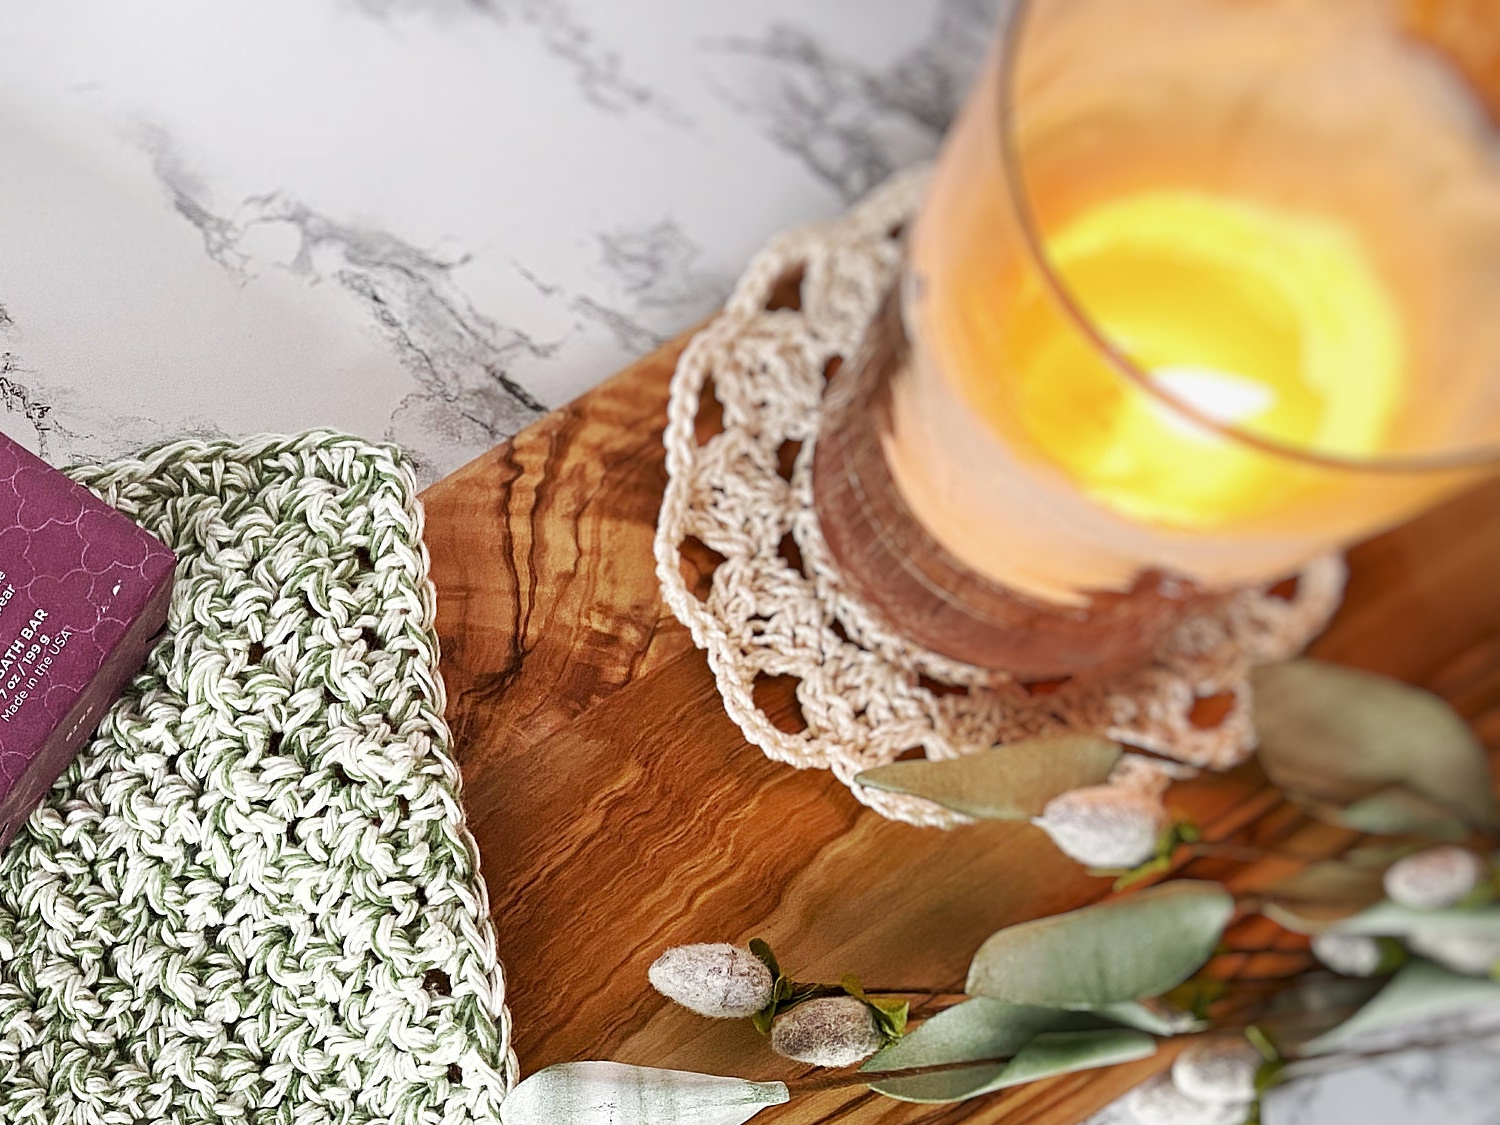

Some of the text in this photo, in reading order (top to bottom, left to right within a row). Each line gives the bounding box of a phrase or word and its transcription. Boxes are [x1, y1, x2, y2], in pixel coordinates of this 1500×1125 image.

[20, 608, 49, 640] BAR
[1, 629, 73, 722] Made in the USA
[7, 674, 21, 689] oz
[22, 644, 42, 665] 199
[39, 634, 51, 645] g
